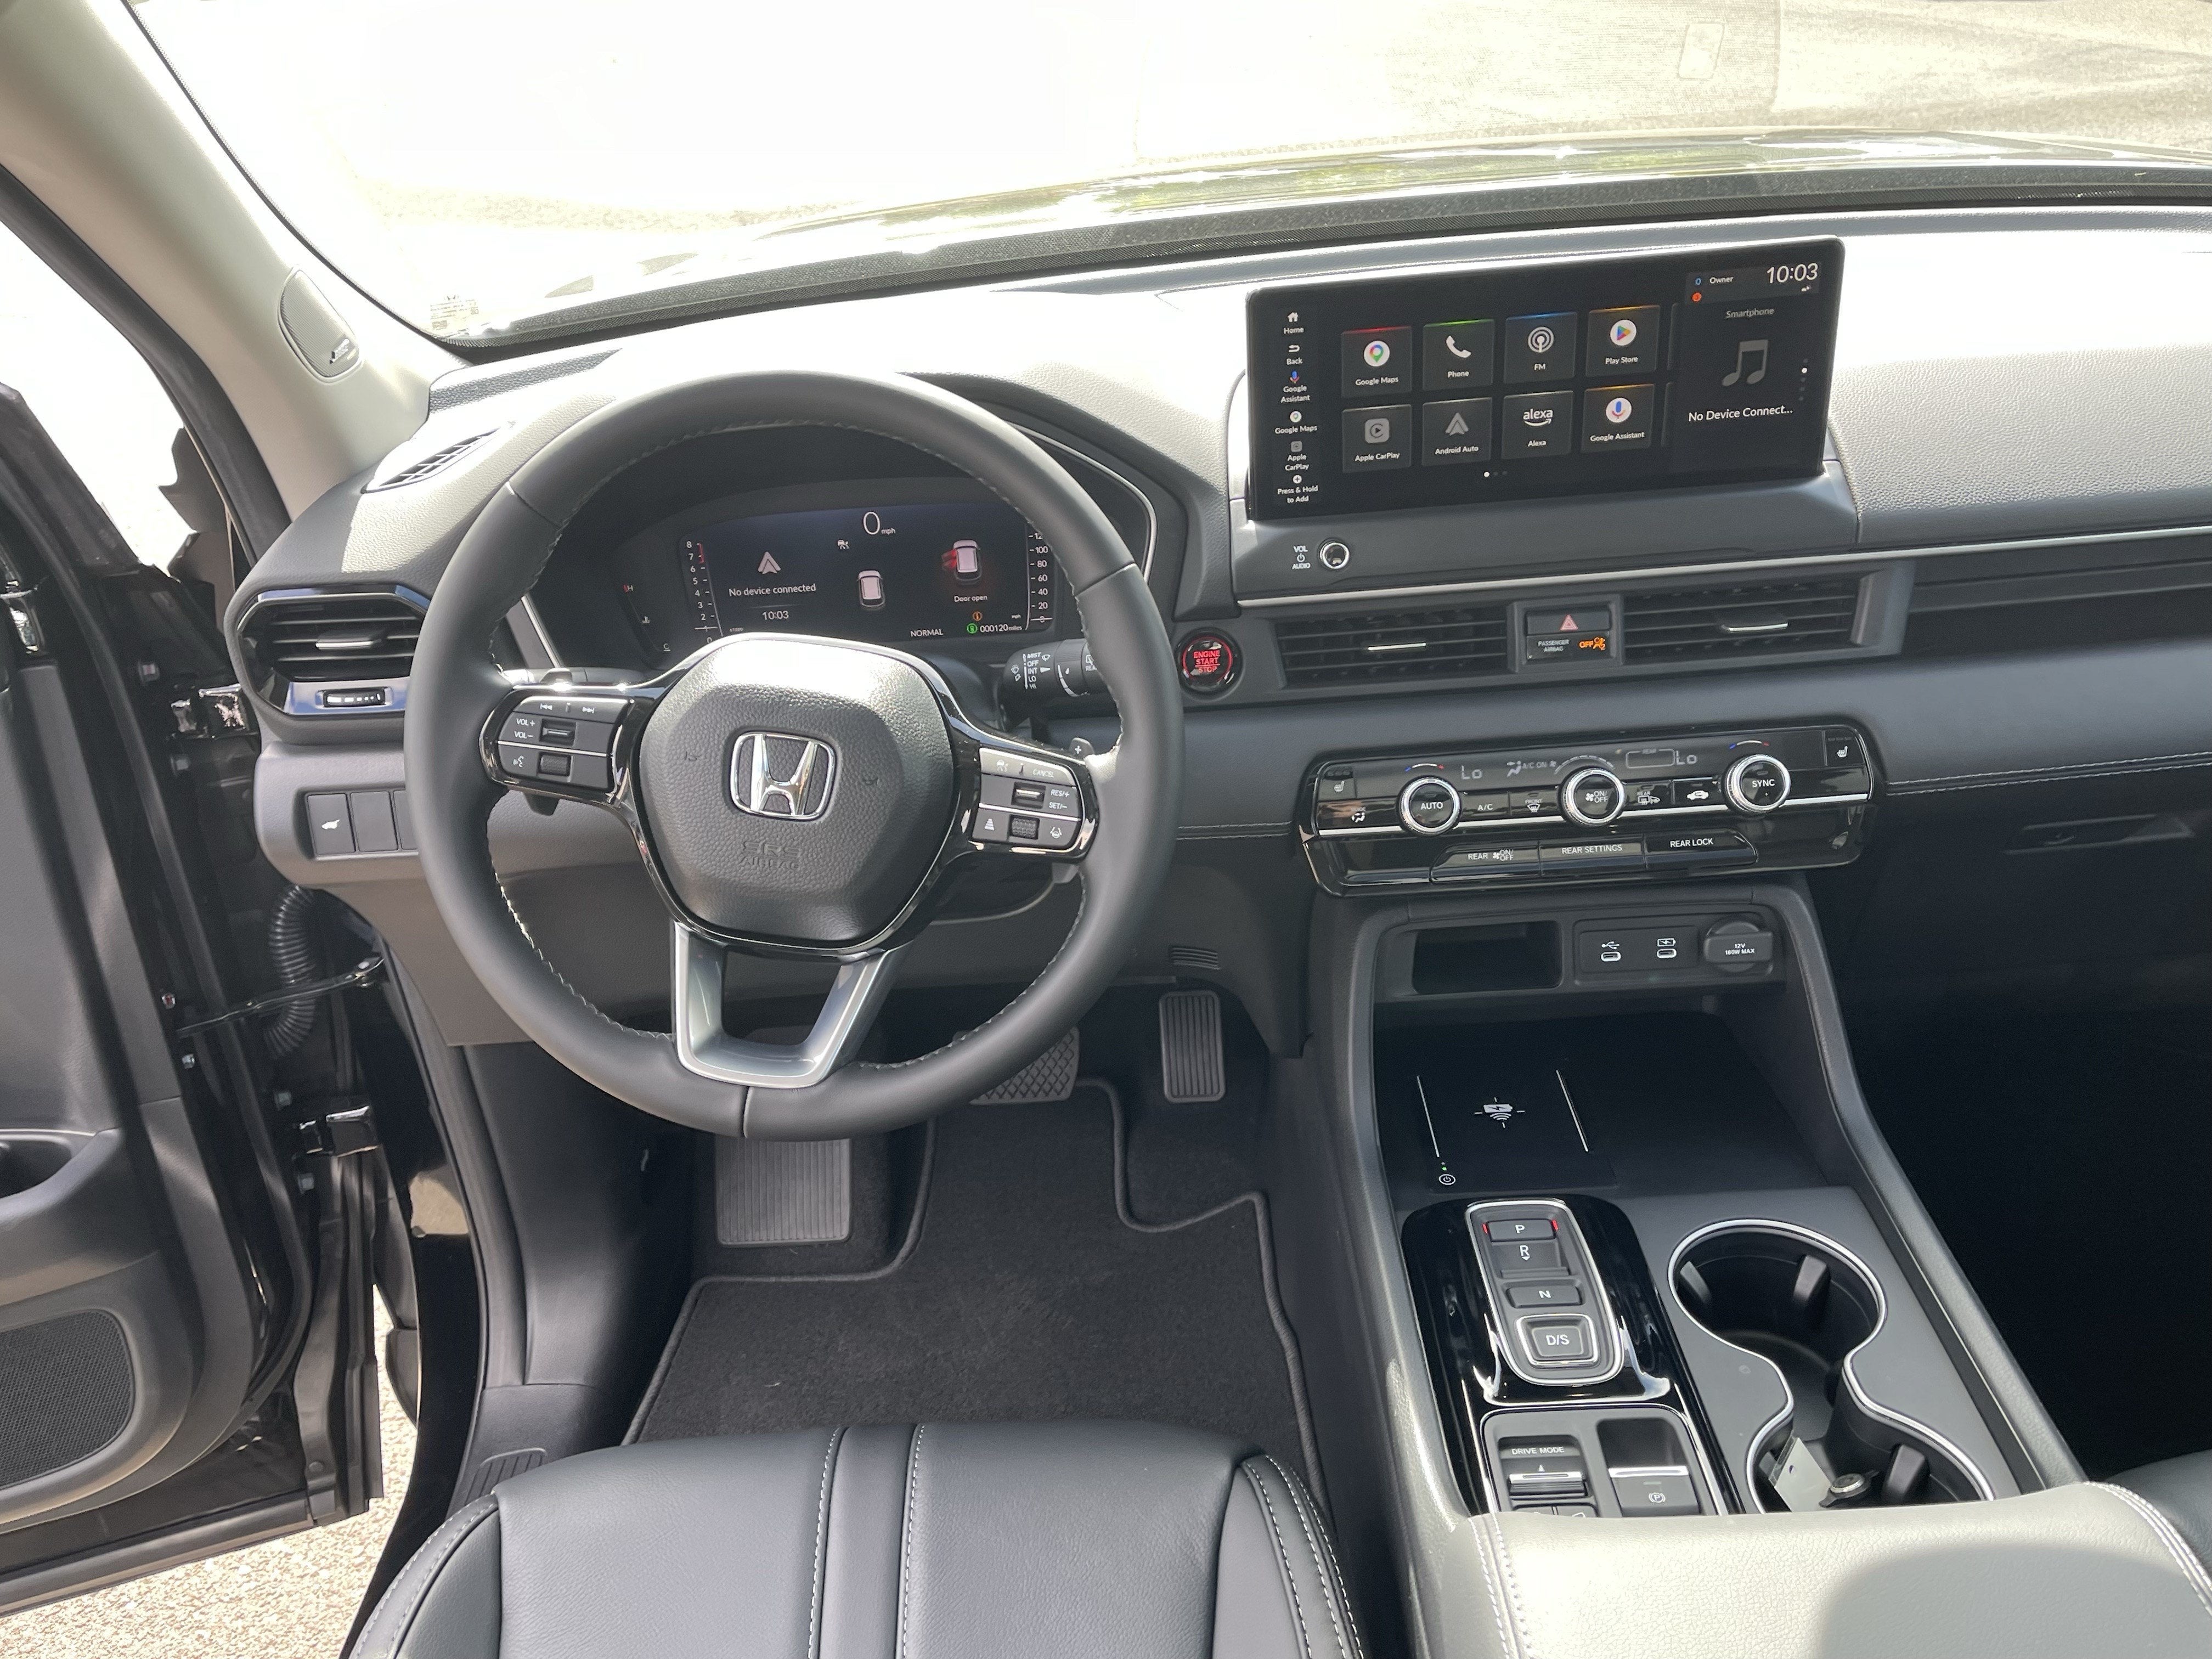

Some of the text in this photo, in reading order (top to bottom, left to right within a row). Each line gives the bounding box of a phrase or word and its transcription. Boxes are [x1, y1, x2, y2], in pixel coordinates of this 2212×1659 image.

[1767, 262, 1819, 284] 10:03
[1709, 276, 1734, 284] Owner
[1725, 308, 1775, 319] Smartphone
[1286, 357, 1304, 365] Back
[1355, 376, 1399, 386] Google Maps
[1283, 385, 1307, 393] Google
[1280, 394, 1311, 403] Assistant
[1522, 408, 1554, 420] alexa
[1688, 411, 1703, 422] No
[1706, 409, 1741, 421] Device
[1274, 426, 1299, 435] Google
[1590, 431, 1645, 442] Google Assistant
[1435, 444, 1479, 455] Android Auto
[1355, 452, 1401, 462] Apple CarPlay
[1295, 495, 1310, 503] Add
[863, 511, 896, 535] 0 mph
[686, 540, 692, 549] 8
[1035, 546, 1048, 554] 100
[688, 552, 694, 561] 7
[1037, 560, 1047, 568] 80
[1037, 574, 1048, 582] 60
[729, 583, 817, 597] No device connected
[1038, 588, 1048, 596] 40
[954, 594, 988, 603] Door open
[1038, 601, 1048, 610] 20
[761, 610, 789, 621] 10:03
[979, 623, 1008, 633] 000120
[910, 628, 944, 638] NORMAL
[1538, 639, 1570, 647] PASSENGER
[1578, 640, 1594, 649] OFF
[1193, 649, 1220, 658] ENGINE
[1026, 659, 1039, 668] OFF
[1198, 665, 1218, 674] STOP
[1028, 675, 1037, 683] LO
[1032, 769, 1054, 778] CANCEL
[1752, 778, 1775, 788] SYNC
[1420, 802, 1444, 810] AUTO
[1477, 803, 1493, 811] A/C
[1670, 837, 1714, 848] REAR LOCK
[1561, 844, 1623, 855] REAR SETTINGS
[1468, 852, 1488, 860] REAR
[741, 855, 799, 870] AIRBAG
[1515, 1224, 1525, 1234] P
[1519, 1245, 1530, 1257] R
[1538, 1290, 1551, 1299] N
[1545, 1334, 1570, 1346] D/S
[1539, 1446, 1565, 1454] MODE
